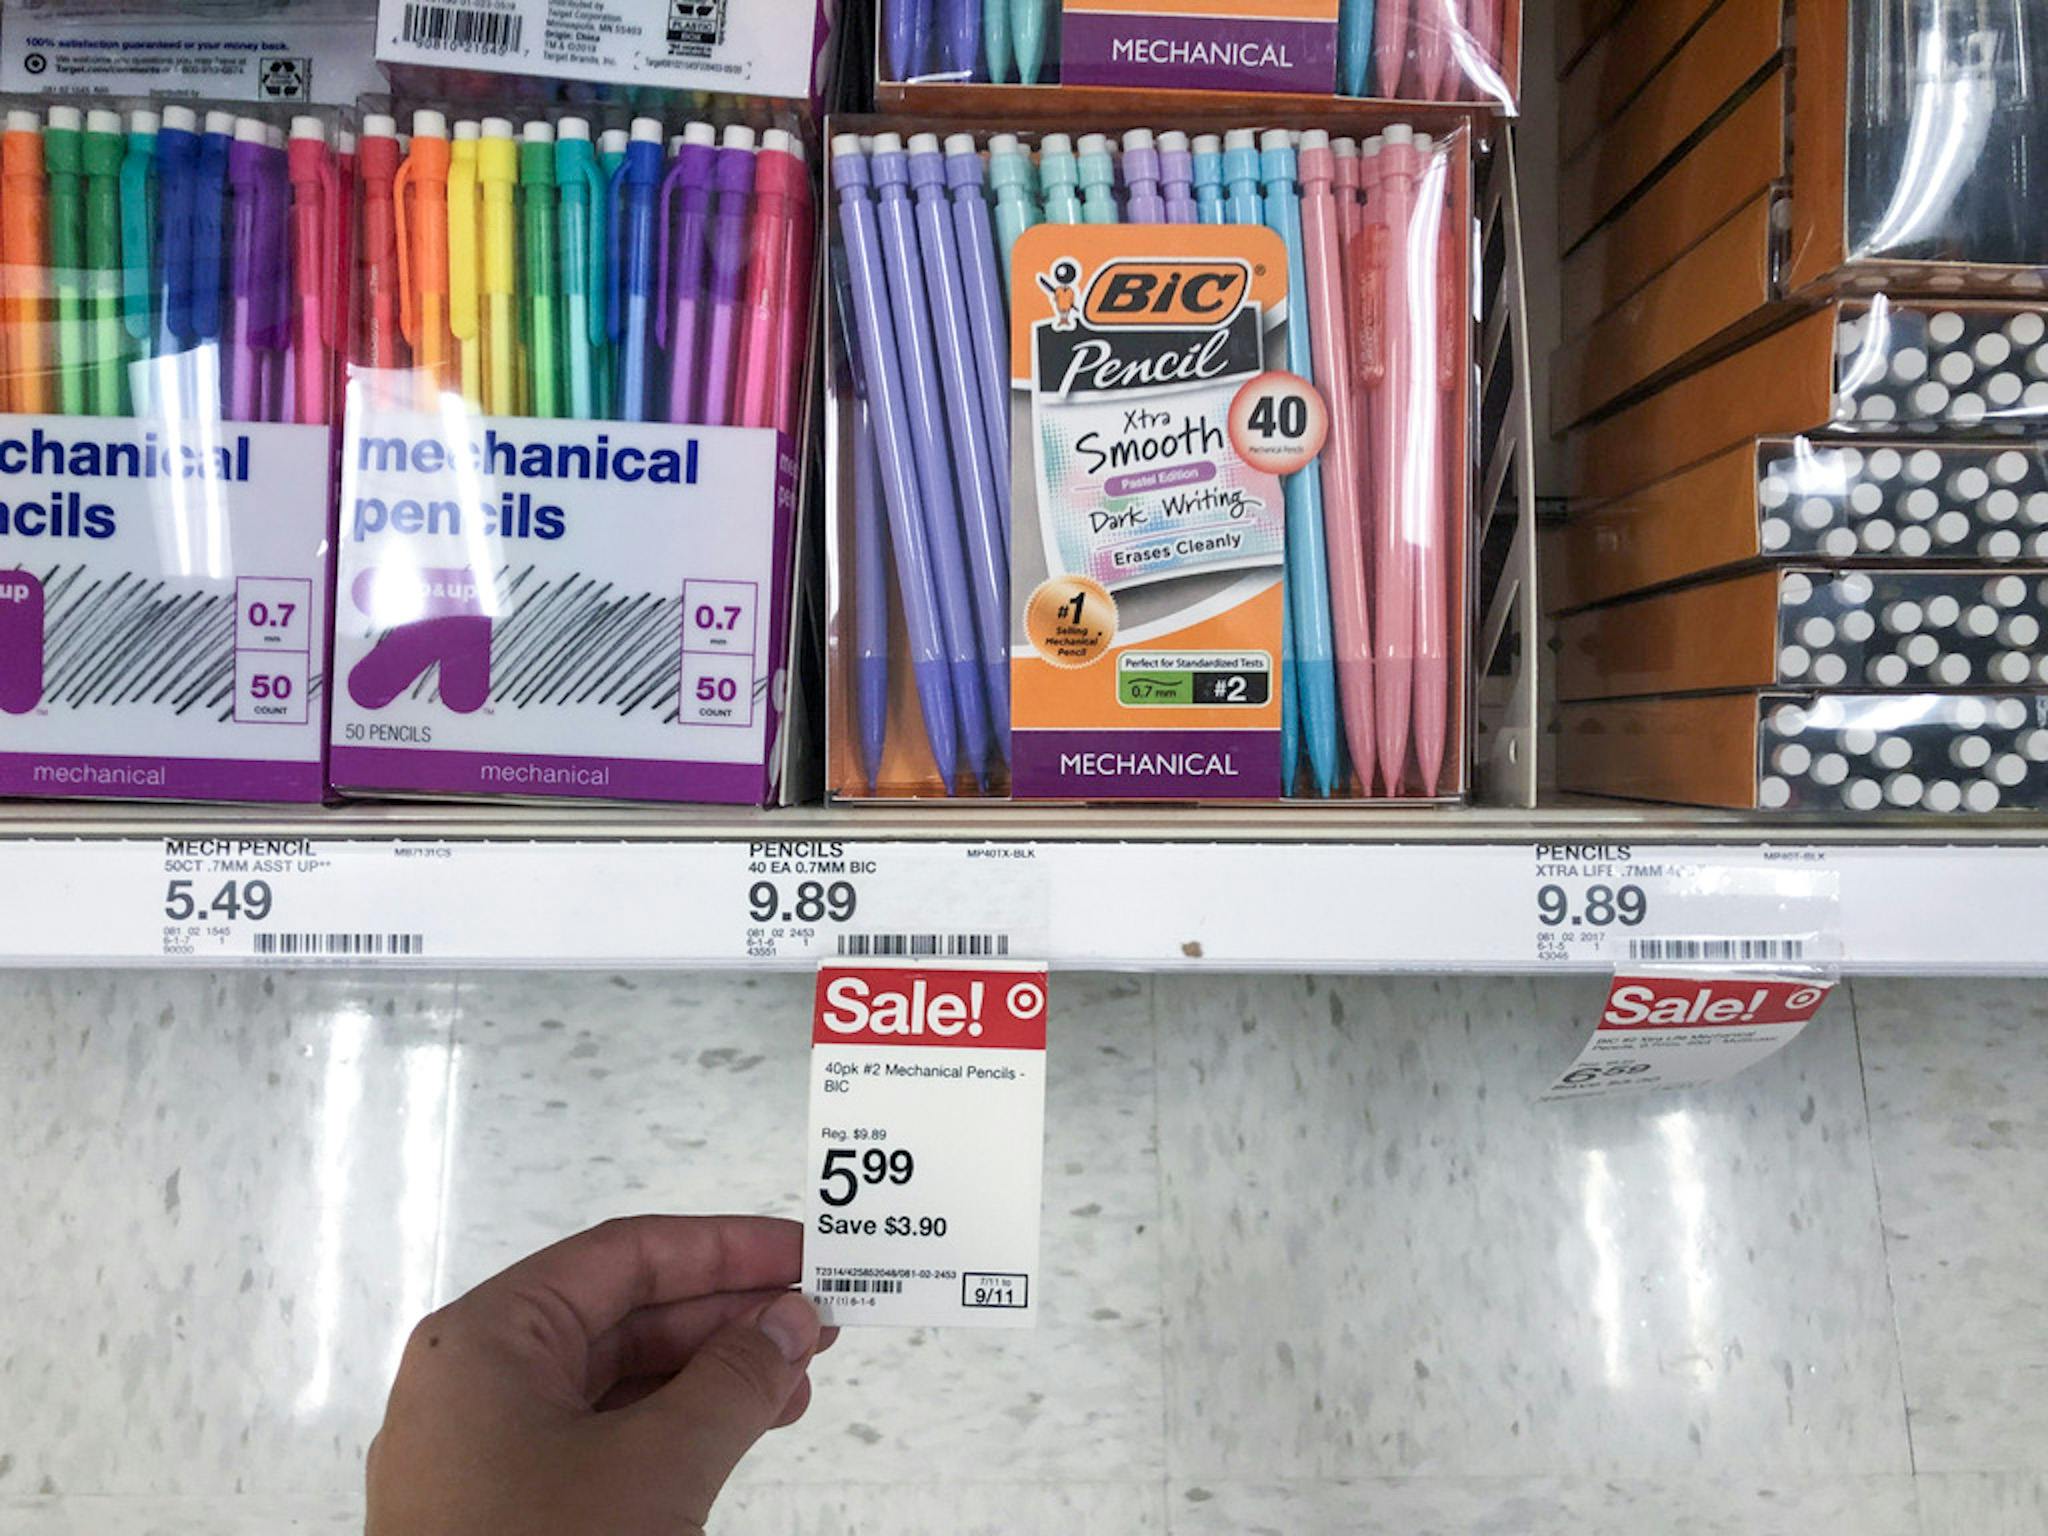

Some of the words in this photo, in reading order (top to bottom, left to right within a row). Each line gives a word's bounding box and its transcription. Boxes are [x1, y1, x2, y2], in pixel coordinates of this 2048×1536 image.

[1112, 38, 1293, 67] MECHANICAL
[1059, 329, 1229, 399] Pencil
[1124, 408, 1170, 434] Xtra
[1248, 395, 1307, 438] 40
[1076, 416, 1224, 474] Smooth
[358, 430, 698, 484] mechanical
[1121, 474, 1156, 490] Pastel
[1158, 468, 1199, 484] Edition
[353, 492, 566, 541] pencils
[1090, 506, 1148, 534] Dark
[1162, 488, 1262, 519] Writing
[1114, 549, 1170, 566] Erases
[1176, 533, 1241, 555] Cleanly
[248, 602, 295, 627] 0.7
[695, 605, 741, 630] 0.7
[1058, 592, 1085, 624] #1
[1056, 627, 1088, 637] Selling
[1057, 648, 1087, 657] Pencil
[1125, 657, 1159, 668] Perfect
[1160, 657, 1173, 668] for
[1176, 657, 1238, 668] Standardized
[1241, 658, 1264, 668] Tests
[250, 674, 292, 700] 50
[696, 677, 737, 701] 50
[1131, 685, 1153, 698] 0.7
[1155, 688, 1177, 697] mm
[1214, 675, 1247, 701] #2
[254, 705, 287, 715] COUNT
[699, 708, 732, 717] COUNT
[345, 724, 365, 740] 50
[369, 725, 432, 743] PENCILS
[34, 763, 165, 785] mechanical
[481, 763, 609, 786] mechanical
[1060, 753, 1239, 776] MECHANICAL
[165, 841, 237, 856] MECH
[238, 841, 317, 856] PENCIL
[750, 842, 844, 858] PENCILS
[1536, 845, 1631, 861] PENCILS
[164, 860, 203, 872] 50CT
[207, 860, 249, 872] .7MM
[252, 860, 293, 872] ASST
[748, 861, 766, 873] 40
[771, 861, 791, 873] EA
[795, 861, 845, 873] 0.7MM
[850, 861, 877, 873] BIC
[1536, 865, 1578, 877] XTRA
[1583, 865, 1613, 877] LIFE
[1621, 865, 1663, 877] .7MM
[165, 879, 273, 921] 5.49
[749, 880, 857, 922] 9.89
[1537, 884, 1646, 926] 9.89
[823, 977, 984, 1037] Sale!
[1605, 985, 1769, 1026] Sale!
[825, 1062, 859, 1077] 40pk
[863, 1063, 881, 1075] #2
[885, 1064, 962, 1078] Mechanical
[967, 1065, 1016, 1080] Pencils
[824, 1080, 849, 1093] BIC
[822, 1128, 848, 1141] Reg.
[853, 1128, 887, 1141] $9.89
[818, 1214, 877, 1235] Save
[884, 1216, 947, 1237] $3.90
[975, 1289, 1013, 1304] 9/11
